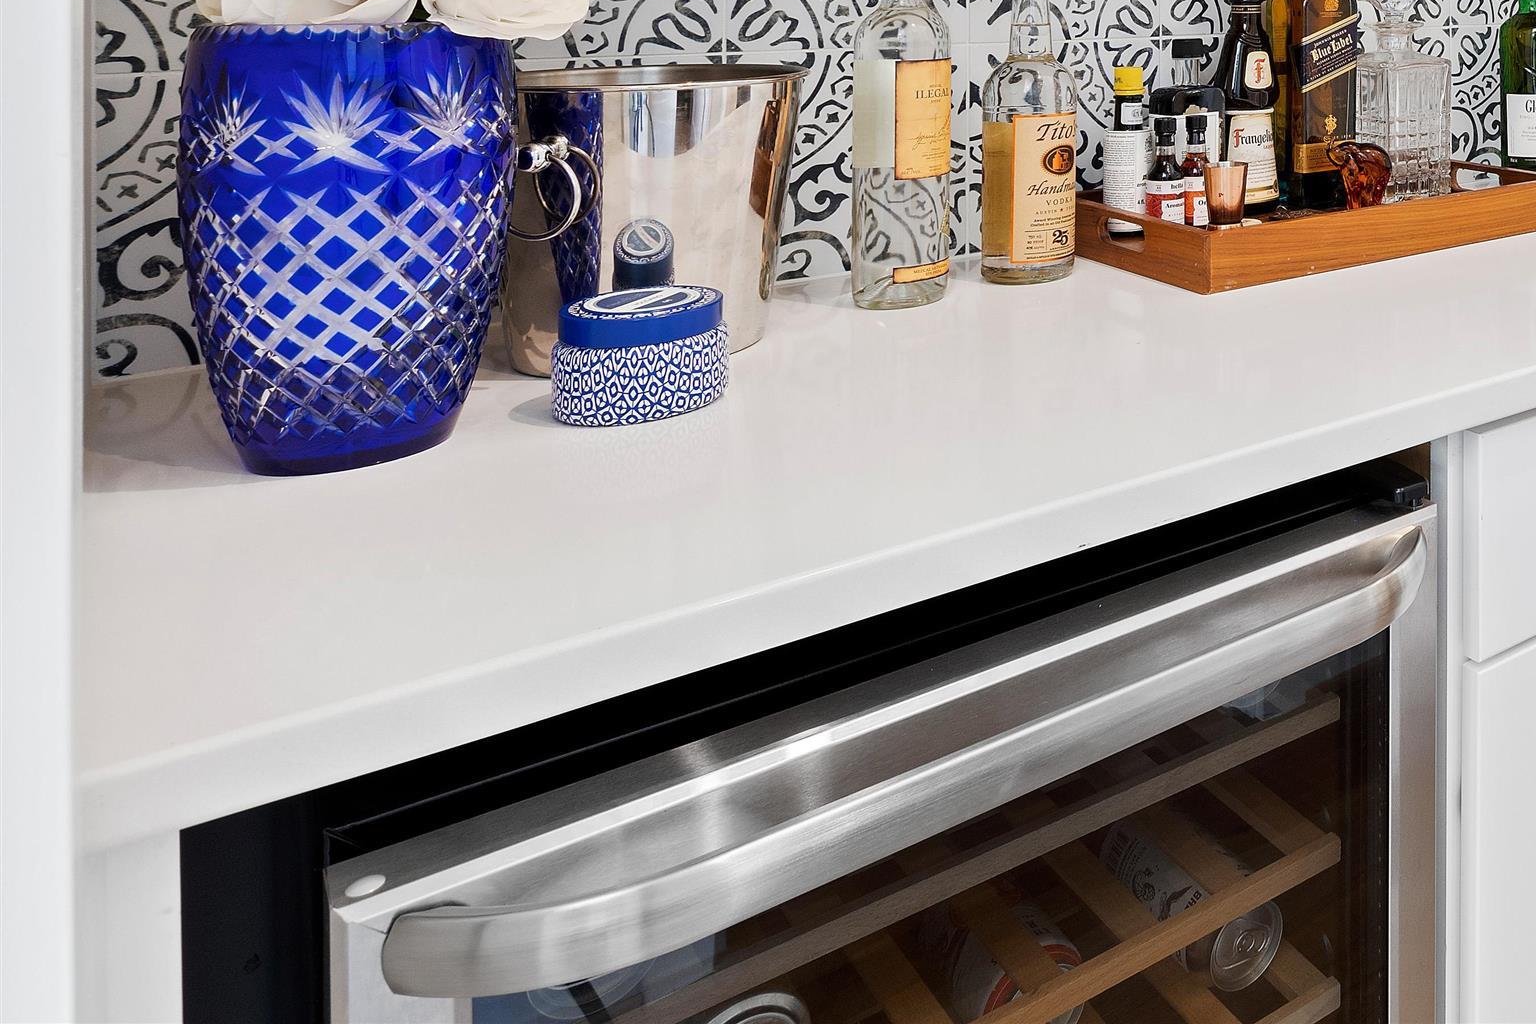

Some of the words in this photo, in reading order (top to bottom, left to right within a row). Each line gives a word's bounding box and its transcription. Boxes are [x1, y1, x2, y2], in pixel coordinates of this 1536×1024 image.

[1310, 45, 1332, 63] Blue
[1330, 33, 1353, 54] Label
[915, 87, 950, 99] ILEGAL
[1052, 229, 1069, 246] 25
